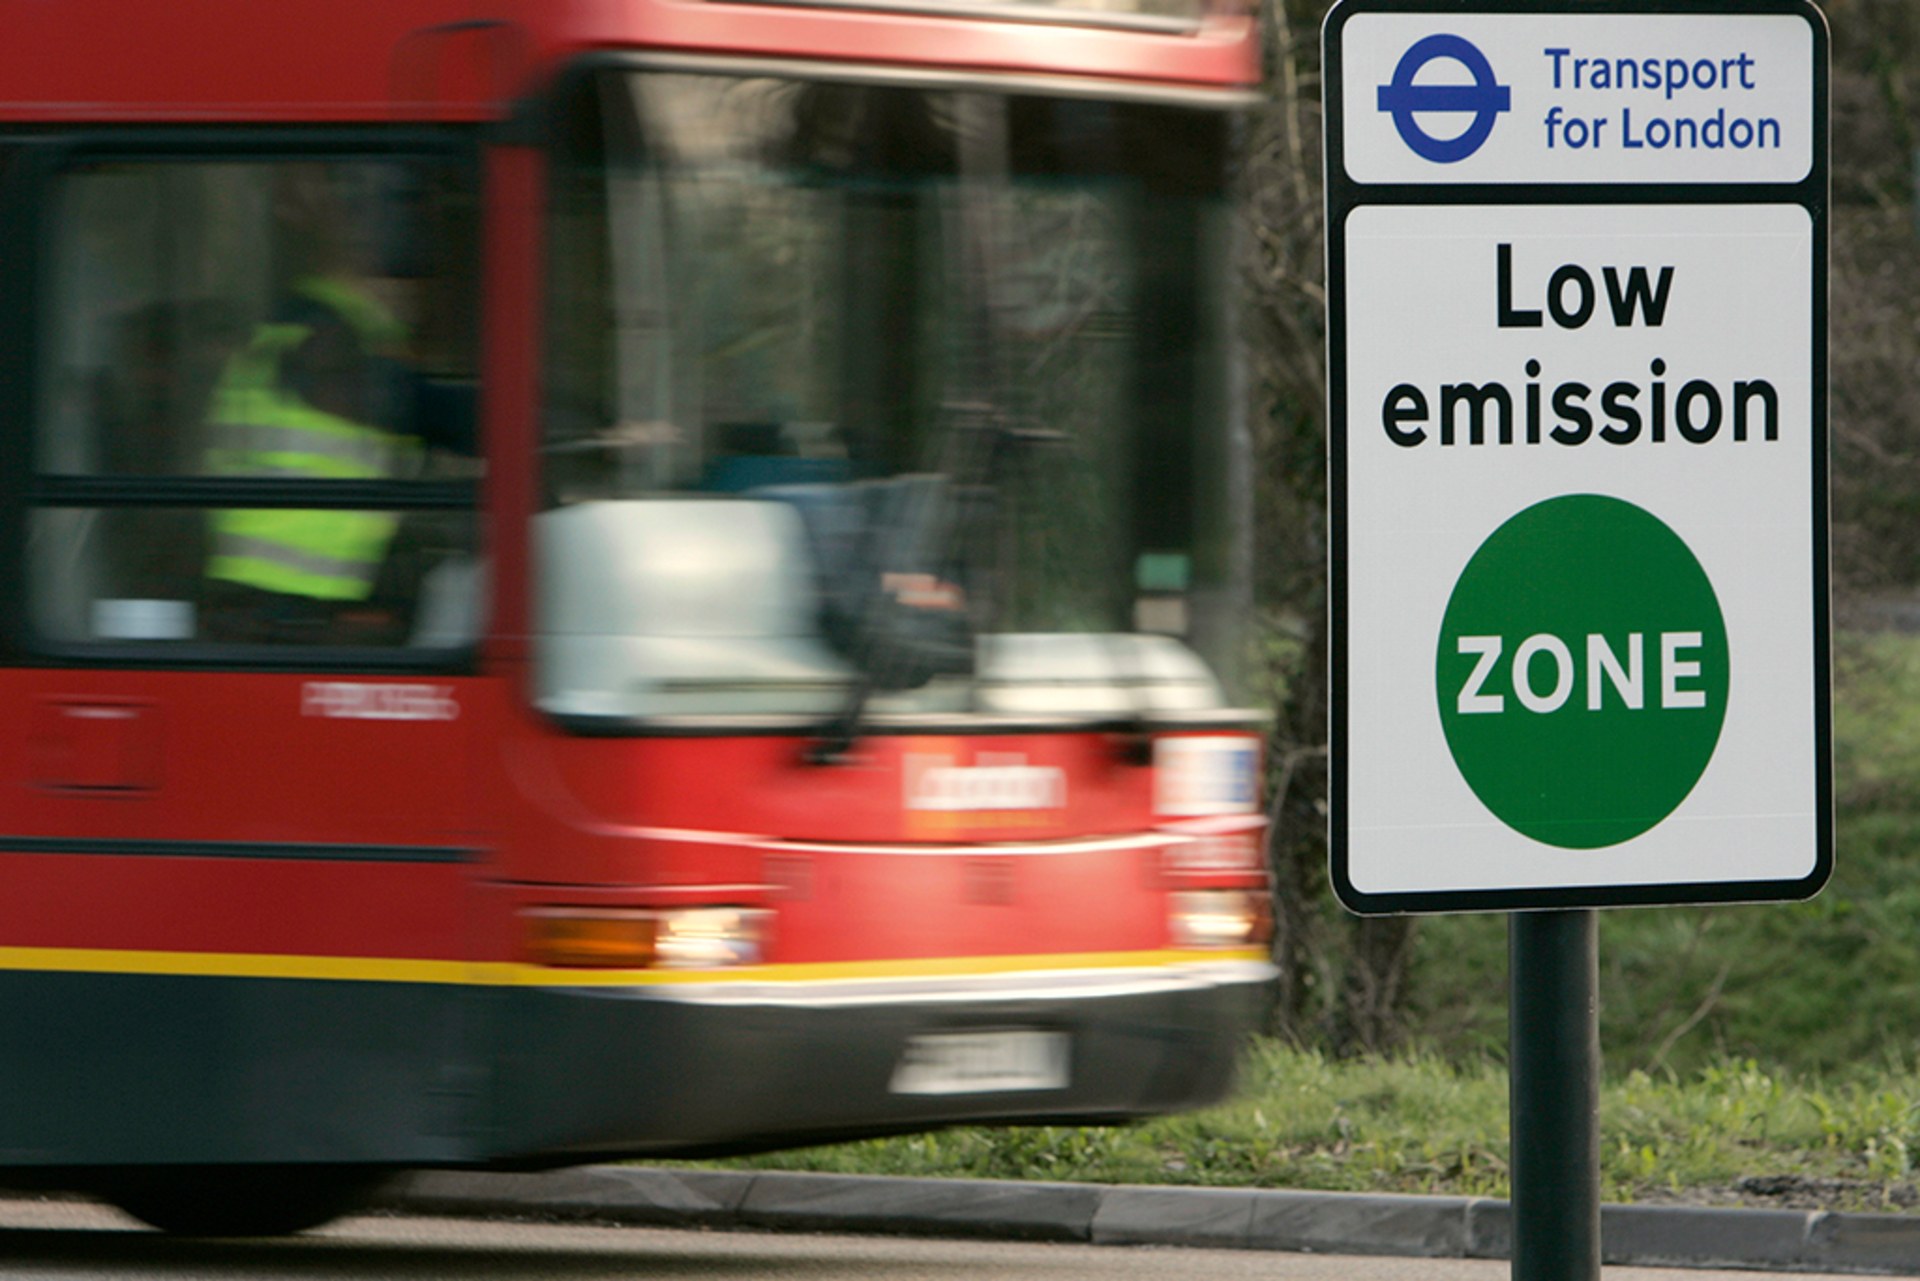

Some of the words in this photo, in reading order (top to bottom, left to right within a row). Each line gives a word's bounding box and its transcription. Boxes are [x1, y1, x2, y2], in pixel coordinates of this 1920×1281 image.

[1544, 48, 1756, 99] Transport
[1543, 107, 1608, 149] for
[1622, 108, 1781, 149] London
[1496, 243, 1675, 329] Low
[1381, 357, 1779, 448] emission
[1456, 631, 1706, 714] ZONE
